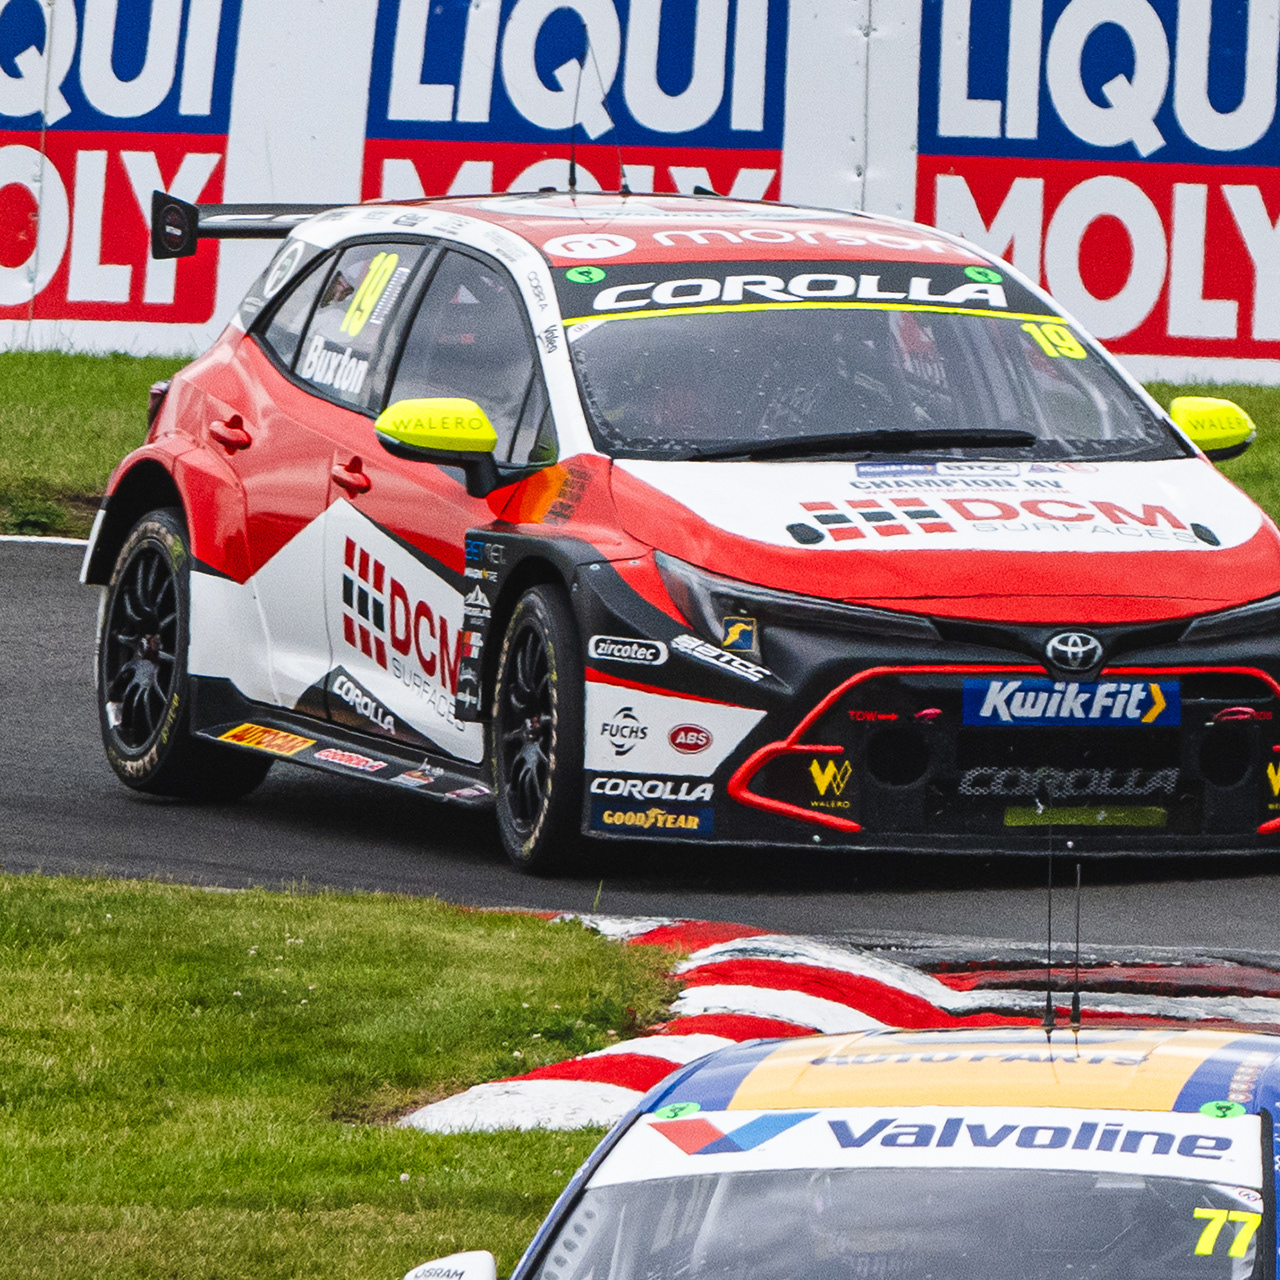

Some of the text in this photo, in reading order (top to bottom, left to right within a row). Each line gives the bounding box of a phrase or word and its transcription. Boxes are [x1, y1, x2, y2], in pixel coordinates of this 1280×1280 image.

[388, 0, 766, 139] LIQUI
[340, 252, 399, 337] 19
[593, 273, 1008, 311] COROLLA
[1021, 322, 1087, 360] 19
[301, 334, 369, 395] Buxton
[392, 413, 484, 433] WALERO
[850, 477, 1065, 491] CHAMPION RV
[941, 497, 1190, 530] DCM
[973, 520, 1198, 544] SURFACES
[597, 640, 656, 661] zircotec
[692, 641, 772, 676] BTCC
[332, 674, 397, 735] COROLLA
[849, 710, 877, 722] TOW
[979, 680, 1147, 722] KwikFit
[222, 725, 312, 755] AUTOCAR
[601, 722, 648, 741] FUCHS
[674, 731, 708, 747] ABS
[590, 777, 714, 802] COROLLA
[959, 767, 1180, 798] COROLLA
[603, 807, 700, 830] GOODYEAR
[810, 800, 851, 808] WALERO
[827, 1116, 1233, 1161] Valvoline
[1194, 1208, 1262, 1258] 77
[414, 1266, 466, 1280] OSRAM
